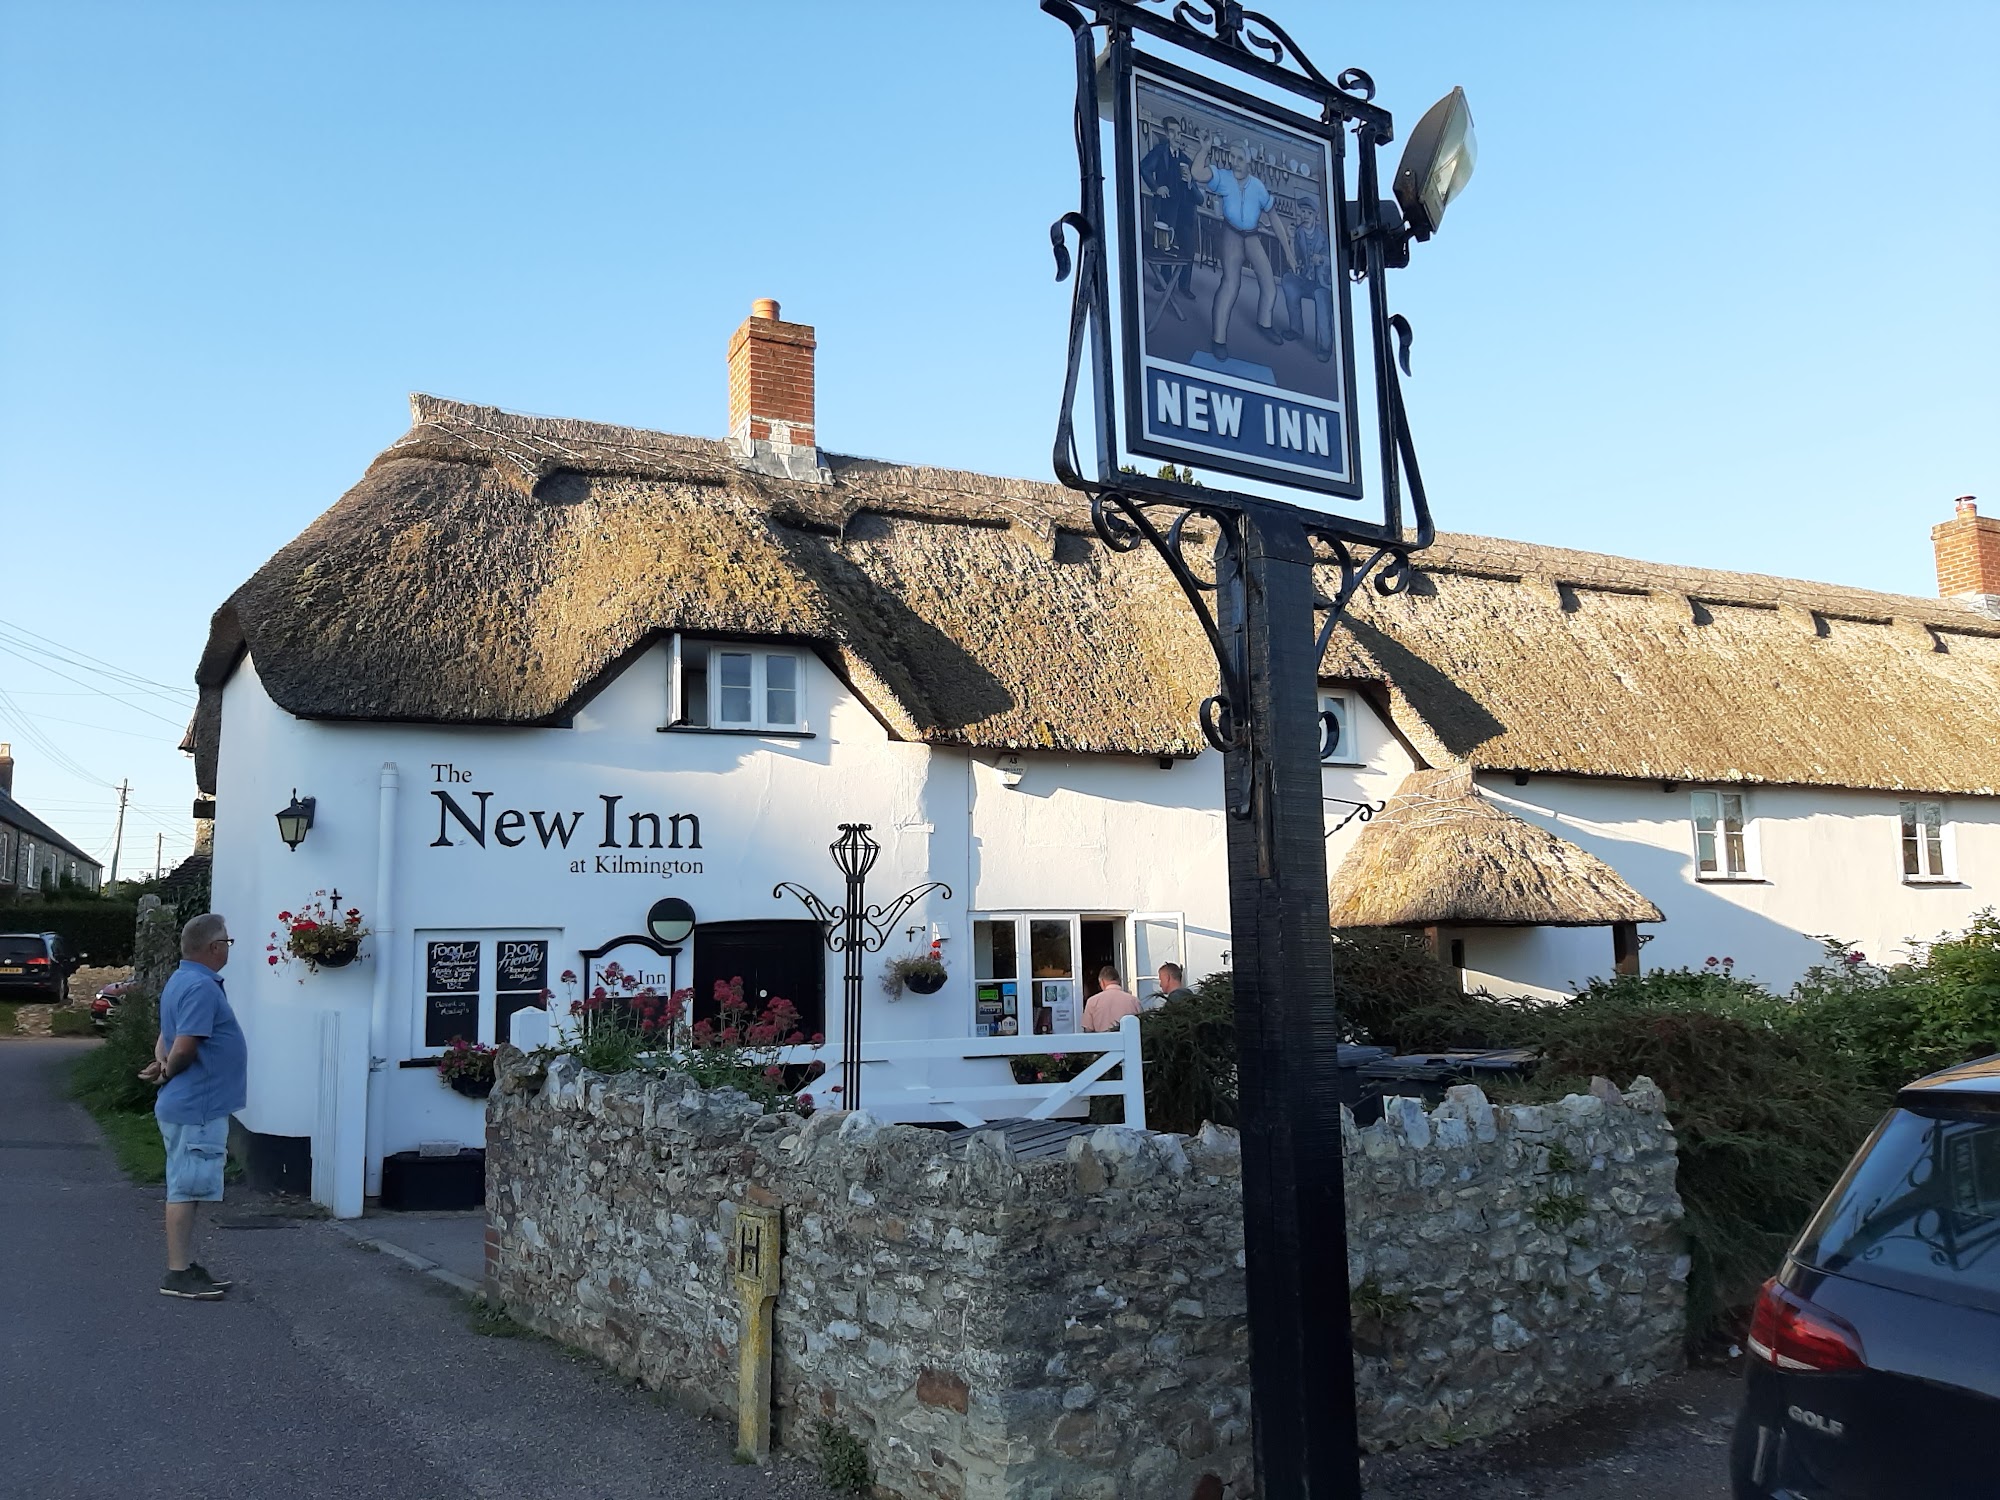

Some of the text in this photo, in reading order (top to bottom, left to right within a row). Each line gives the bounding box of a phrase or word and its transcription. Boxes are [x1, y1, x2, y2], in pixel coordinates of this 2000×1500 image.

[1156, 379, 1330, 457] NEW INN
[430, 763, 472, 783] The
[430, 790, 703, 850] New Inn
[570, 855, 703, 879] at Kilmington
[504, 943, 539, 955] DOG
[638, 969, 666, 985] Inn
[739, 1222, 762, 1278] H
[1788, 1405, 1843, 1436] GOLF
